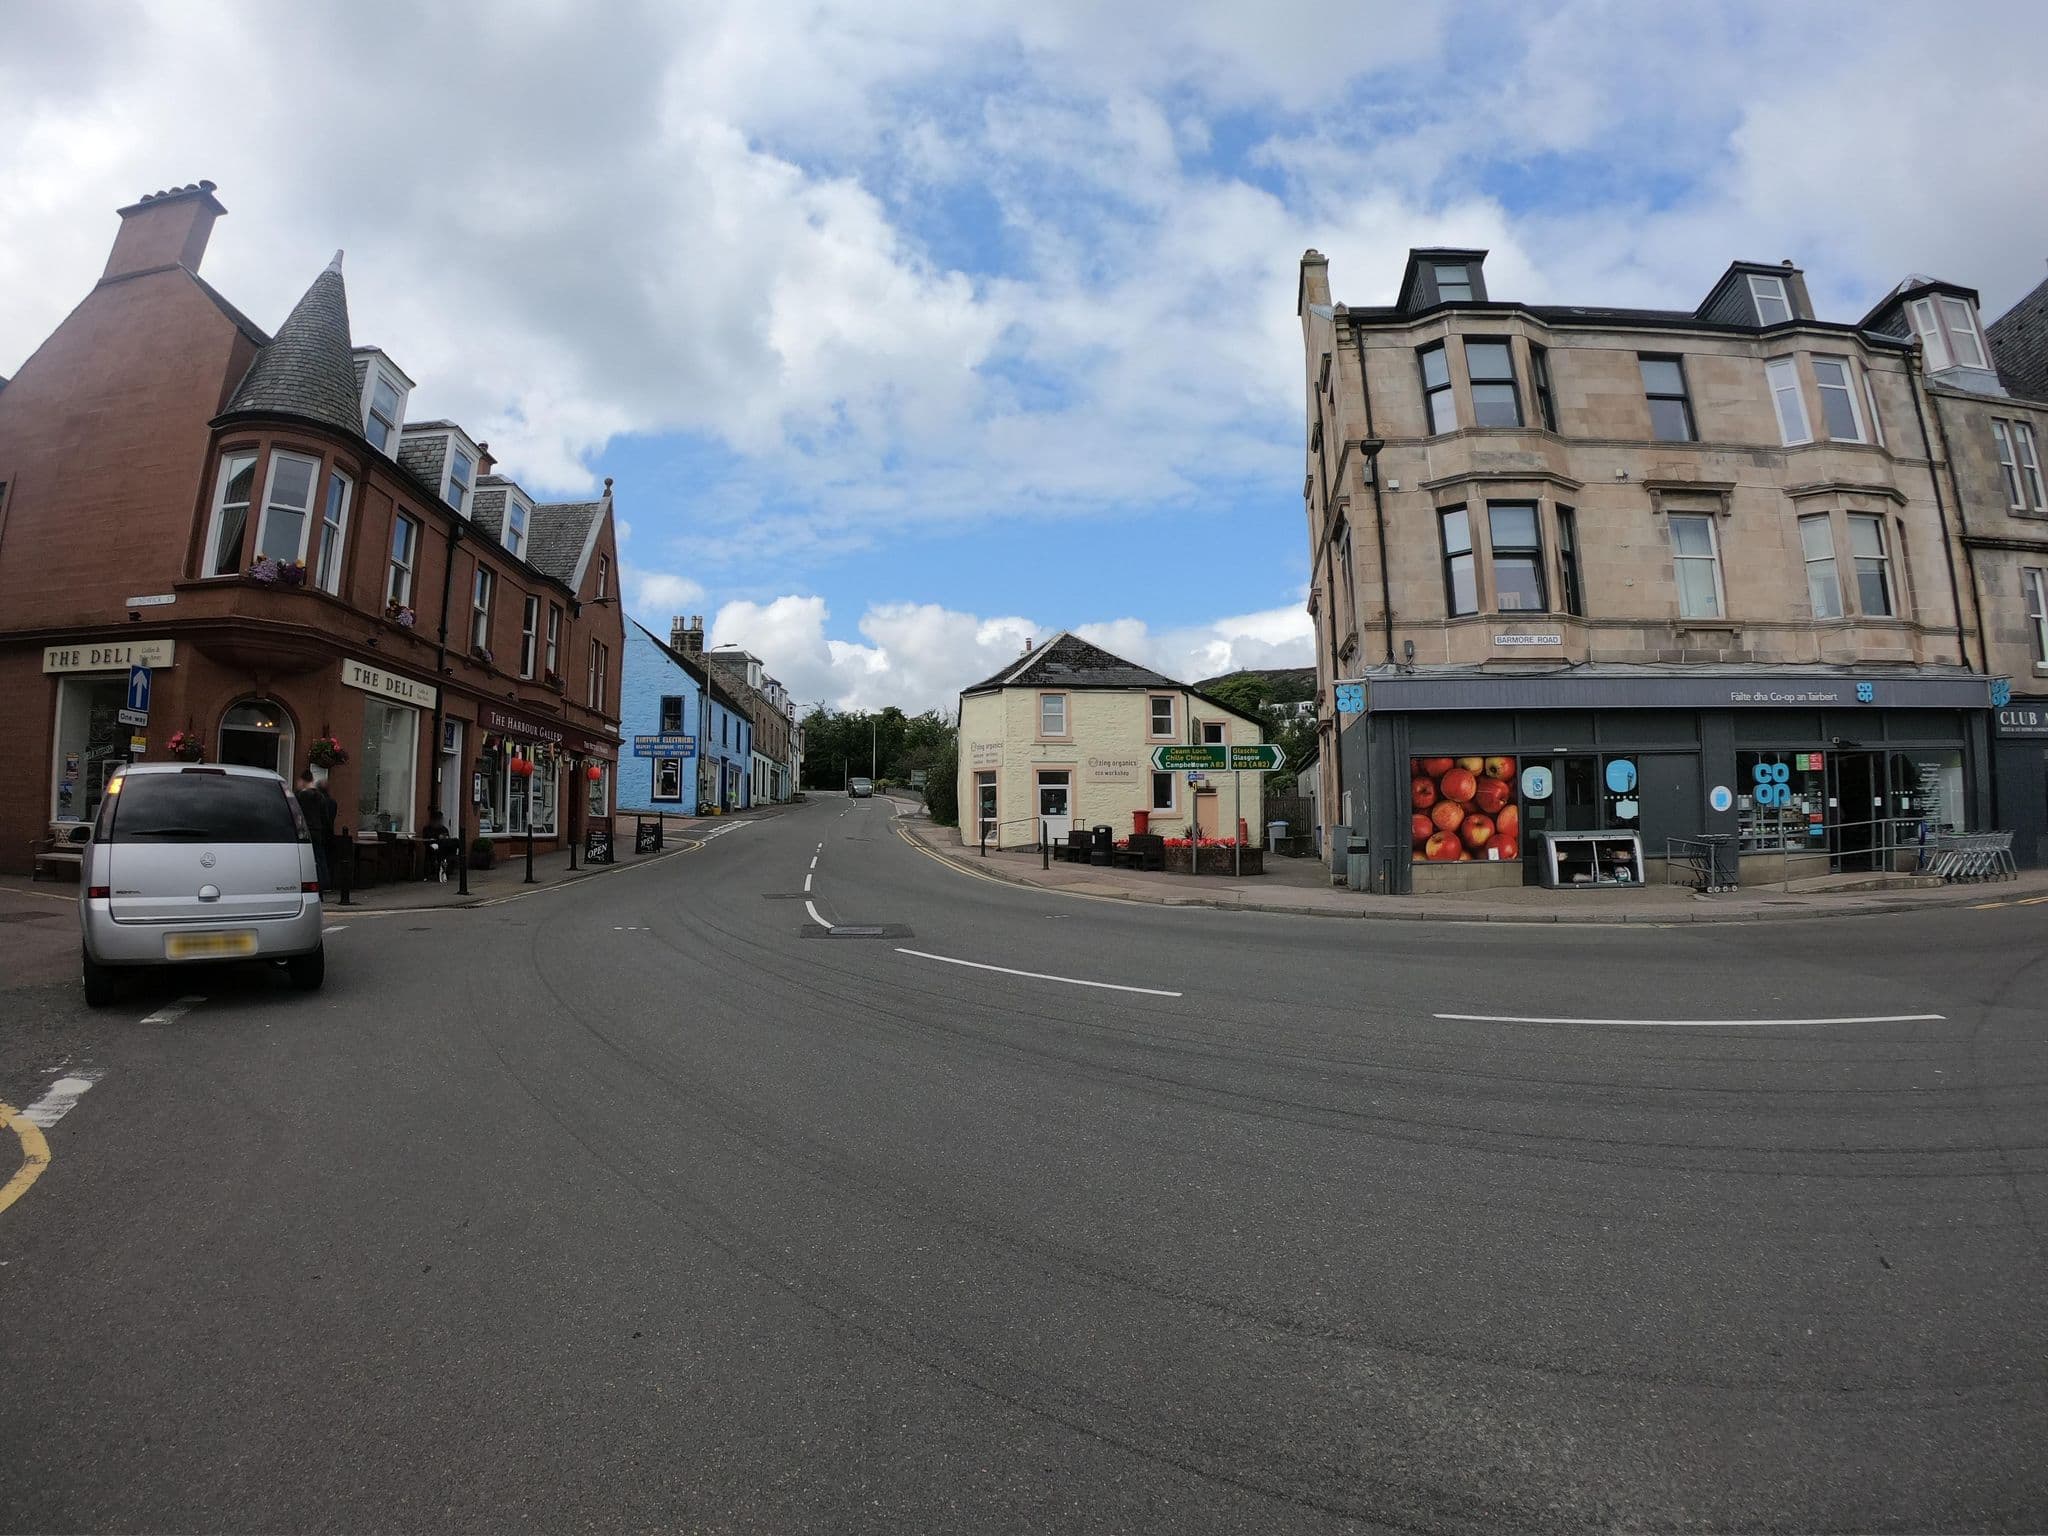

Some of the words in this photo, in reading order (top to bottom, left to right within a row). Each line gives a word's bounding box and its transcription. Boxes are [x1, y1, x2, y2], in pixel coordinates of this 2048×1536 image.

[1537, 636, 1559, 644] ROAD
[49, 650, 80, 667] THE
[90, 647, 131, 664] DELI
[354, 667, 379, 687] THE
[386, 677, 413, 698] DELI
[1753, 691, 1768, 701] dha
[1770, 692, 1795, 703] Co-op
[120, 712, 132, 721] One
[134, 716, 146, 725] way
[490, 711, 506, 727] THE
[507, 717, 539, 736] HARBOUR
[2000, 711, 2038, 725] CLUB
[1232, 754, 1260, 762] Glasgow
[1232, 761, 1247, 769] A83
[587, 843, 608, 859] OPEN
